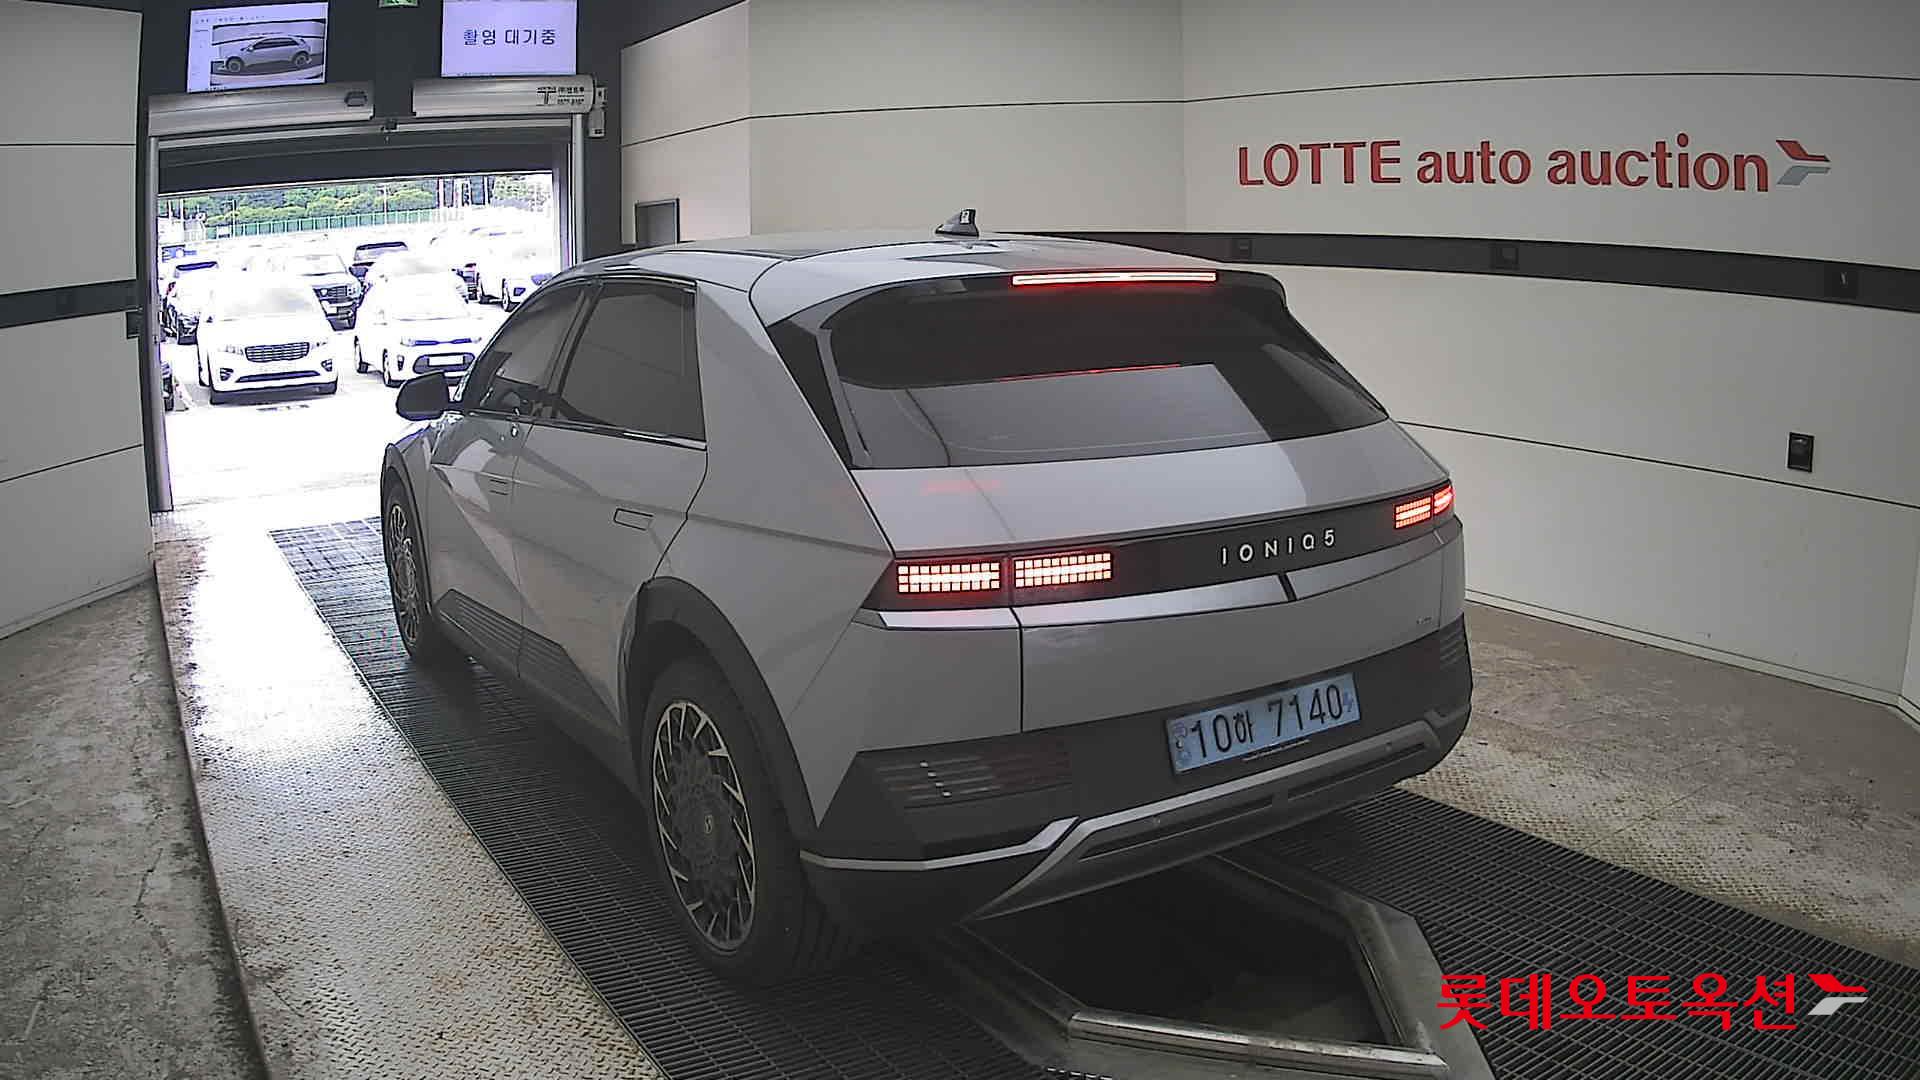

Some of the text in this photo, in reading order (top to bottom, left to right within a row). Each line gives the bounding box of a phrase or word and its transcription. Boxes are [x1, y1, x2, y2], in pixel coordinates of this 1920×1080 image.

[504, 28, 556, 45] 대기중
[1238, 132, 1770, 192] LOTTE auto auction
[1190, 684, 1343, 759] 10하 7140
